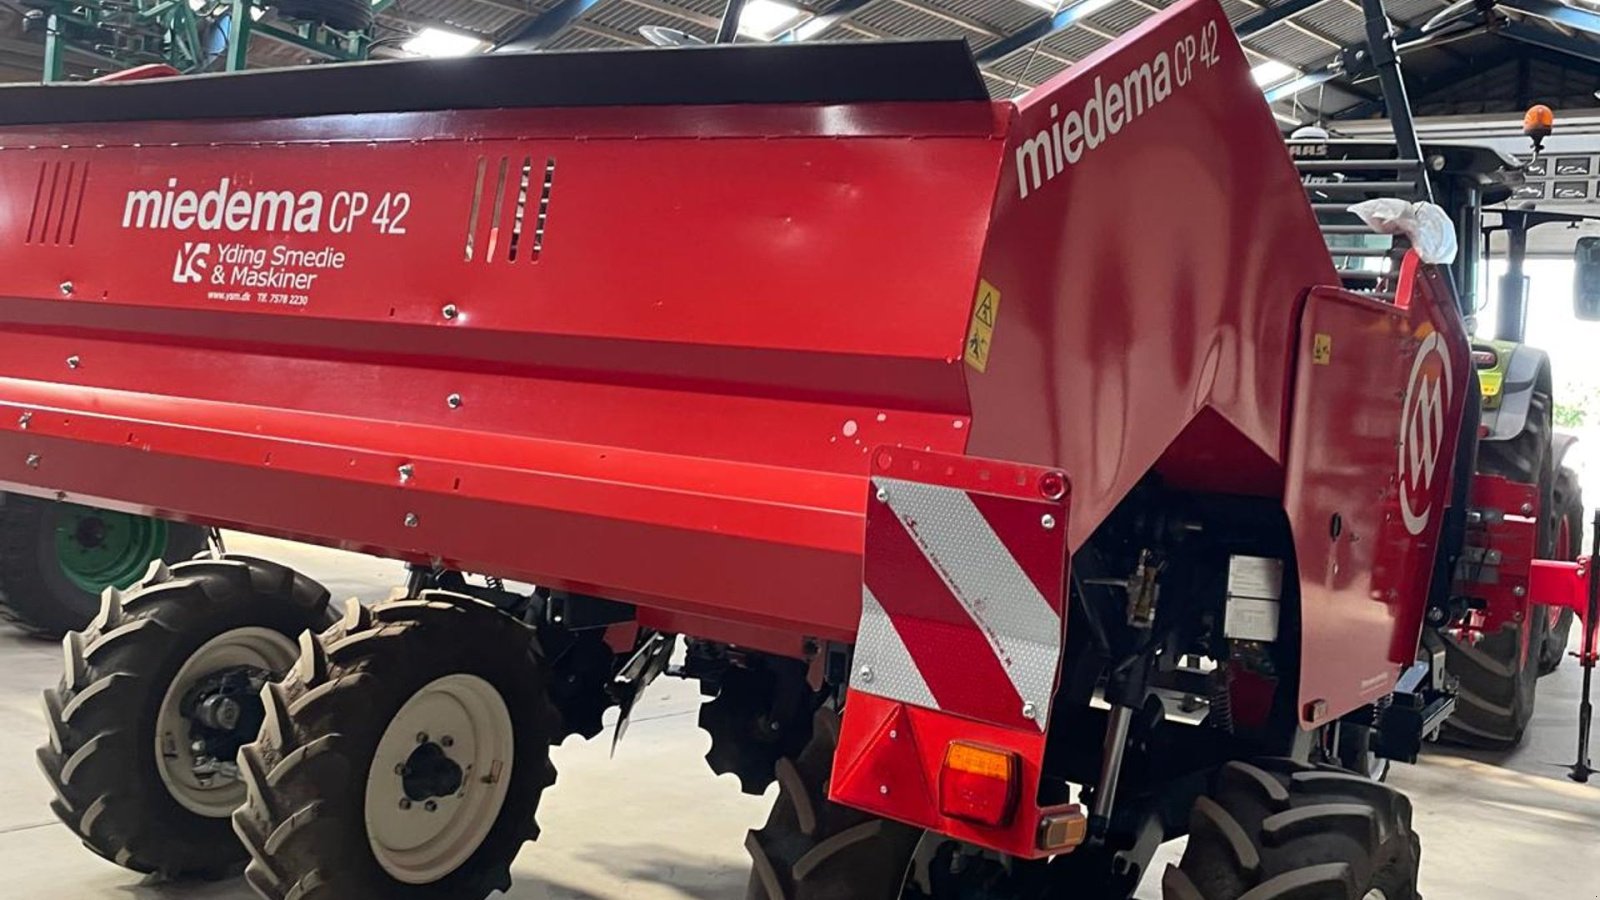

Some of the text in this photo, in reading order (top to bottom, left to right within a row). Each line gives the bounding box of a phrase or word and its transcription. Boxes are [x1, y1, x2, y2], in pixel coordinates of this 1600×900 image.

[1016, 19, 1221, 199] miedema CP 42
[122, 177, 411, 234] miedema CP 42
[217, 243, 346, 269] Yding Smedie
[211, 264, 318, 290] & Maskiner
